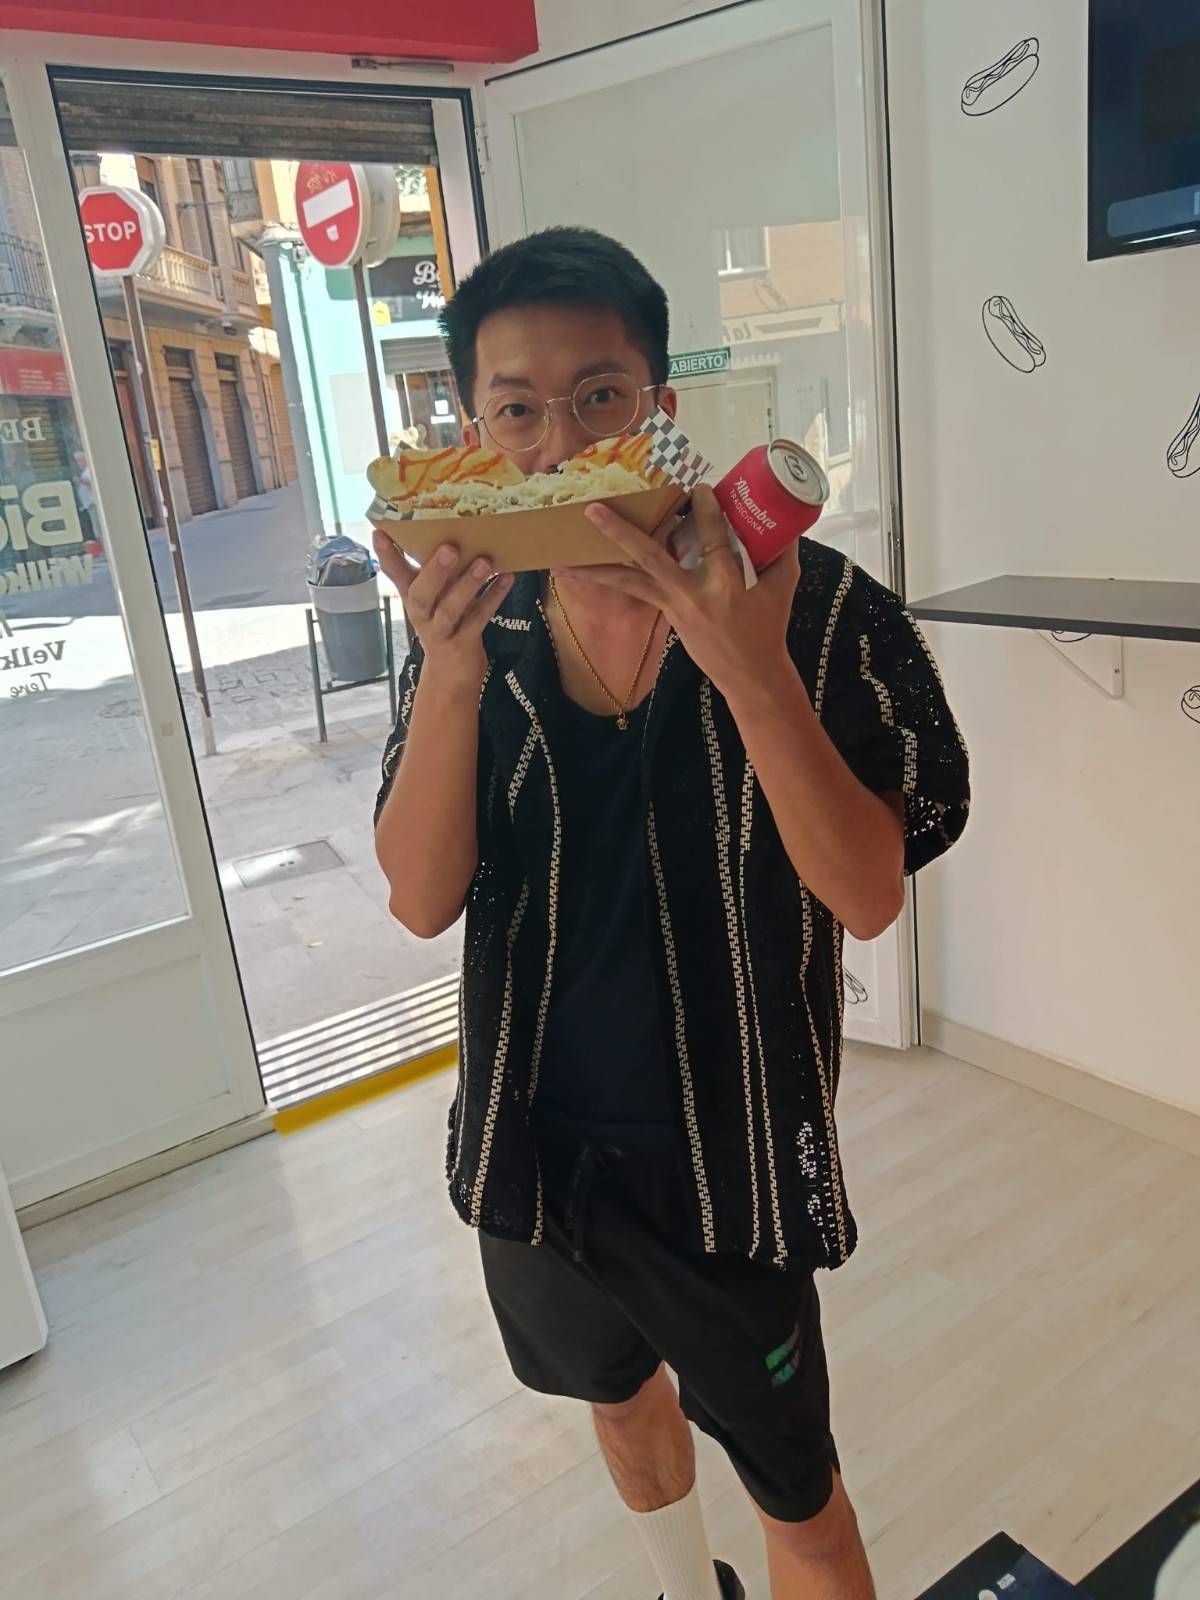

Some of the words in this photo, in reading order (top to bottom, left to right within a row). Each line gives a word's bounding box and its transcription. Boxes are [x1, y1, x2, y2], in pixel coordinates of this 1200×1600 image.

[84, 221, 137, 244] STOP
[413, 260, 441, 286] B
[670, 355, 724, 374] ABIERTO
[729, 488, 766, 536] TRADICIONAL
[733, 476, 777, 530] Alhambra
